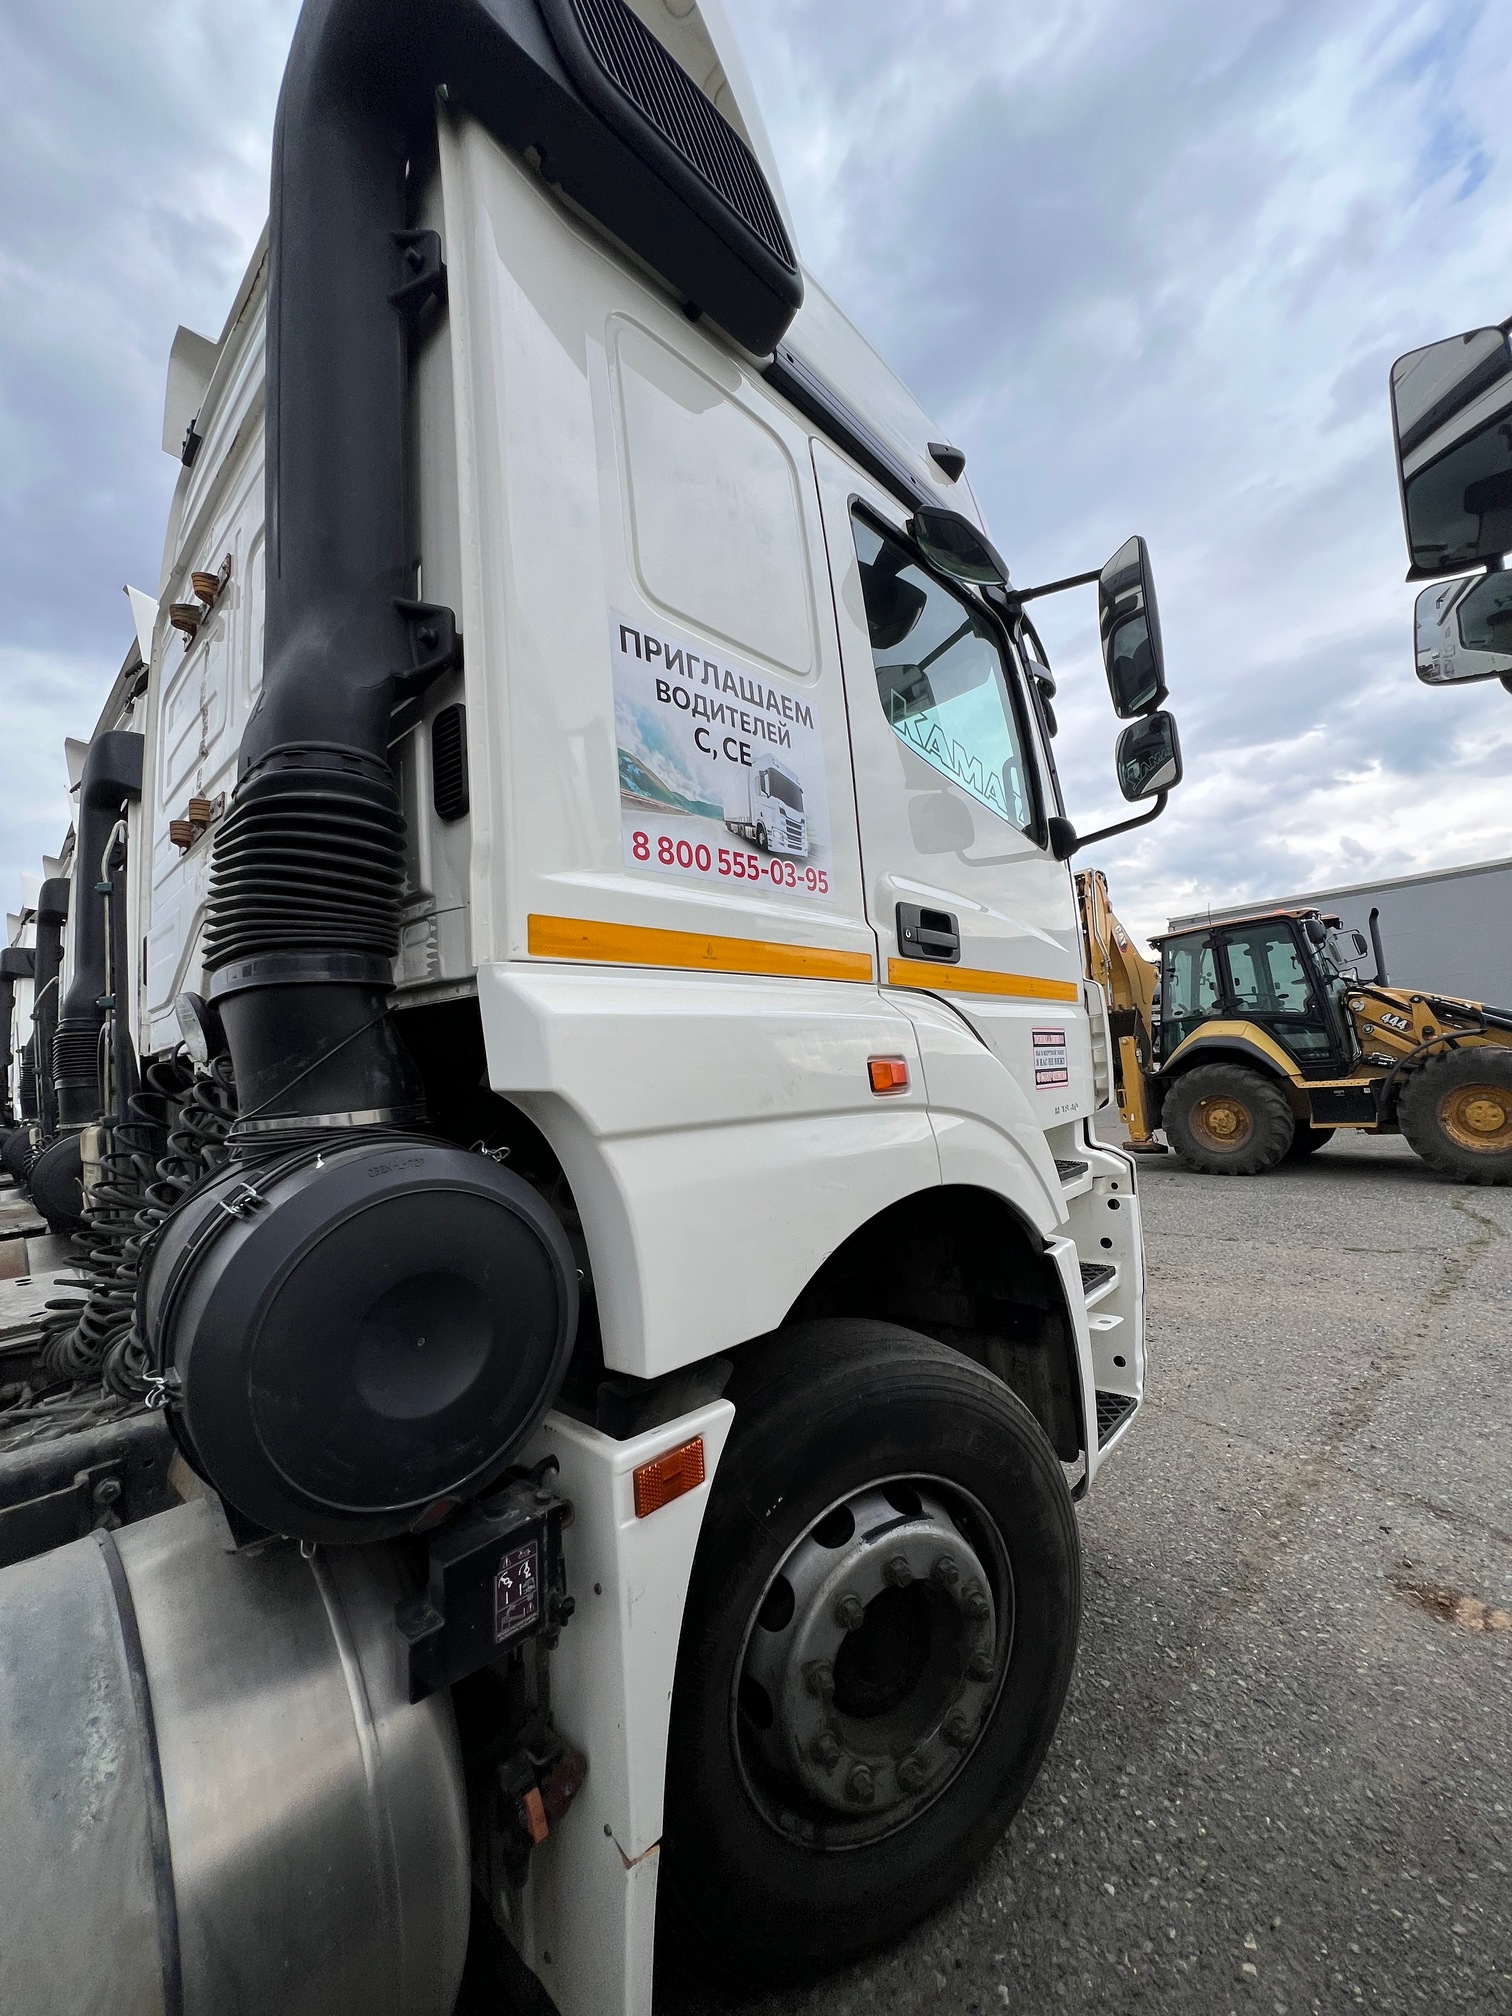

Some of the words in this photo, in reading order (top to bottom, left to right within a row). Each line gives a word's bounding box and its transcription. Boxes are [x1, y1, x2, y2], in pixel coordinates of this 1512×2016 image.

[618, 624, 815, 730] ПРИГЛАШАЕМ
[655, 678, 792, 749] ВОДИТЕЛЕЙ
[890, 688, 1029, 829] KAMA
[632, 831, 651, 861] 8
[657, 836, 712, 872] 800
[717, 848, 829, 894] 555-03-95
[1381, 1012, 1409, 1030] 444
